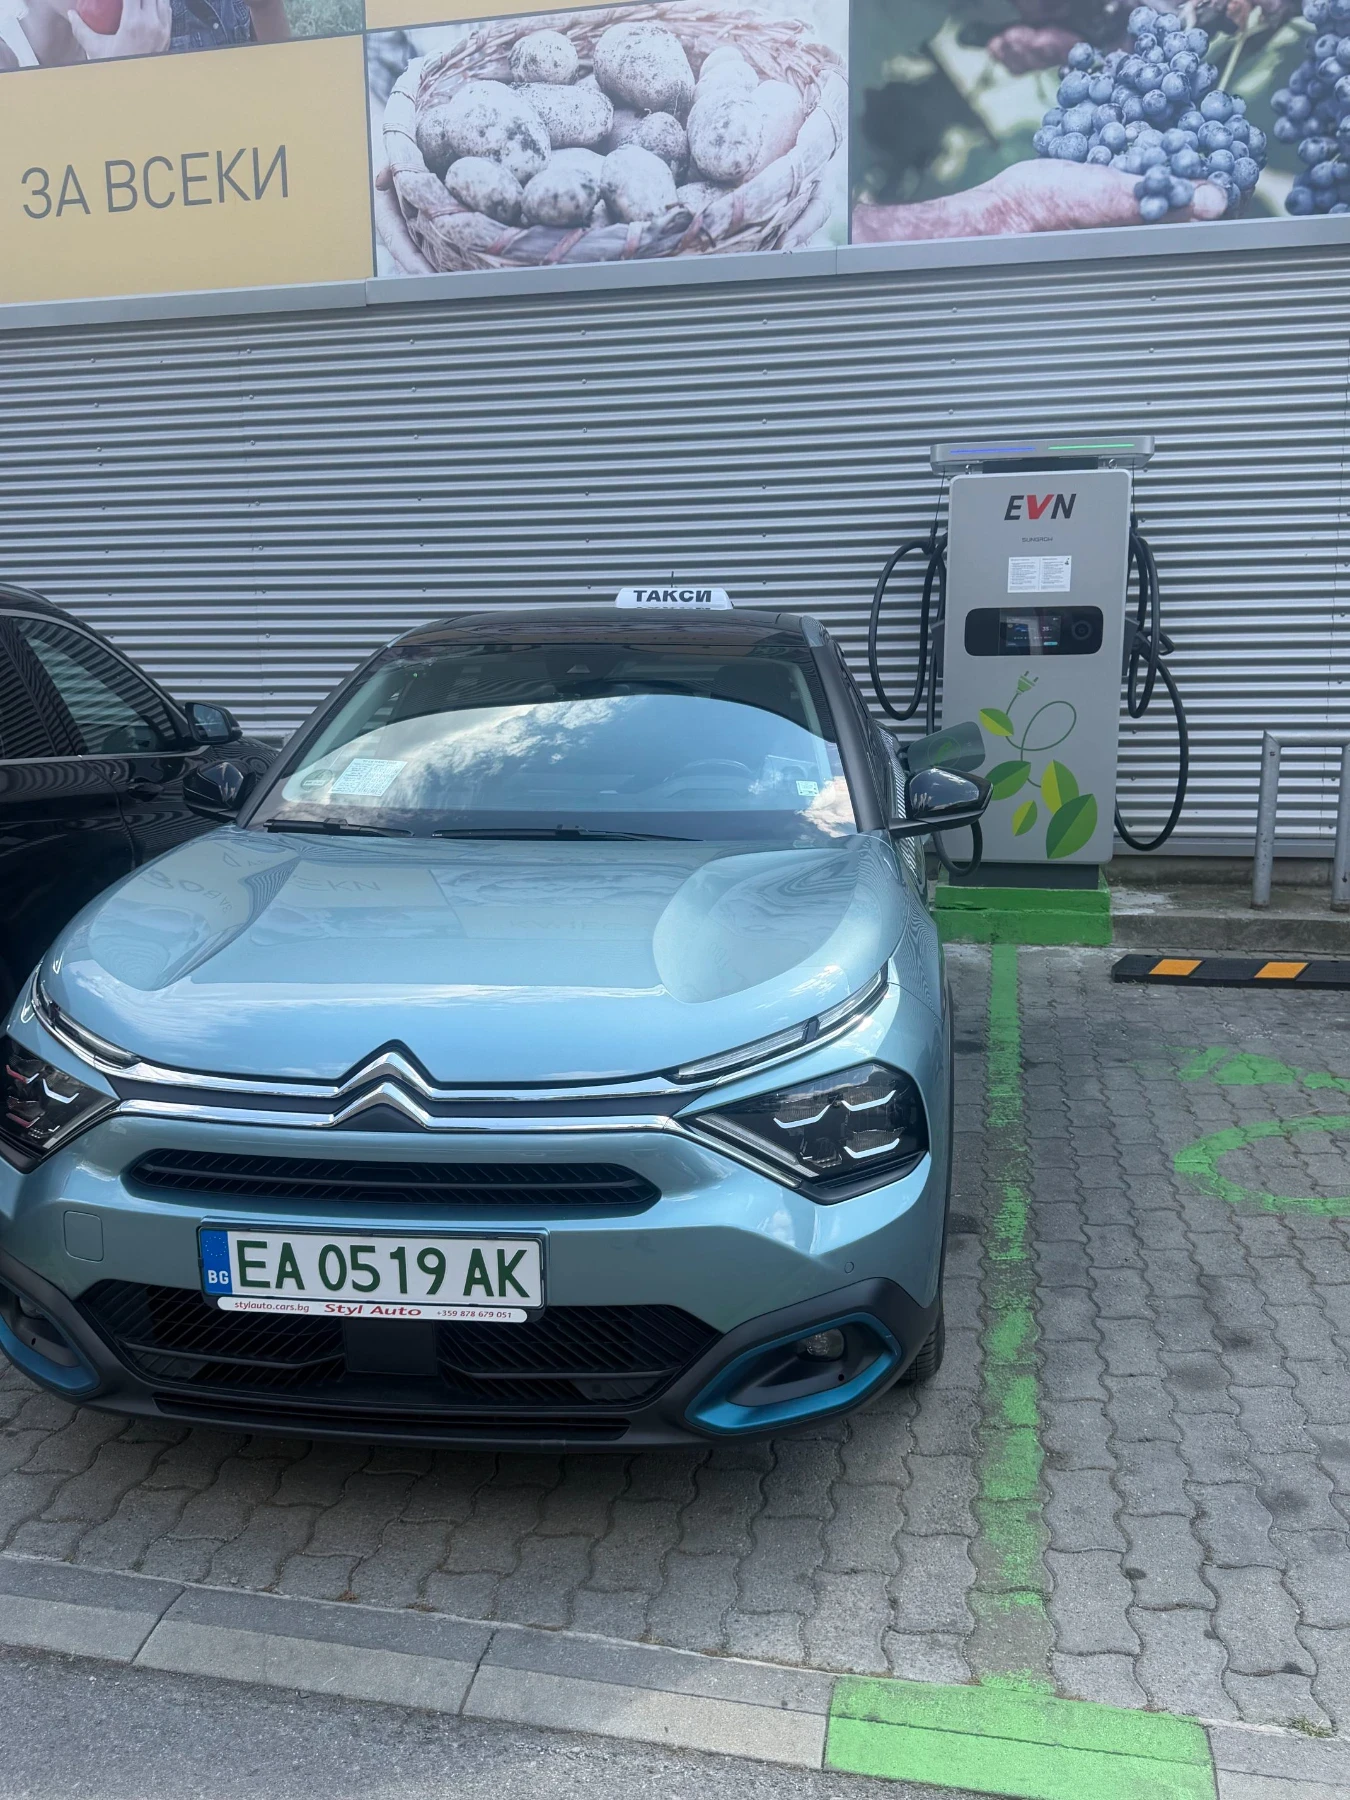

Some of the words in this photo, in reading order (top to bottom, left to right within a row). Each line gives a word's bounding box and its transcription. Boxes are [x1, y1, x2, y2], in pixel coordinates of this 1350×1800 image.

[21, 164, 91, 220] ЗА
[105, 145, 289, 213] ВСЕКИ
[1004, 493, 1077, 521] EVN
[633, 590, 712, 603] ТАКСИ
[236, 1240, 305, 1290] EA
[318, 1243, 446, 1295] 0519
[463, 1248, 530, 1298] AK
[207, 1269, 229, 1284] BG
[234, 1301, 310, 1313] stylauto.cars.bg
[324, 1303, 363, 1316] Styl
[370, 1305, 422, 1316] Auto
[478, 1310, 494, 1318] 679
